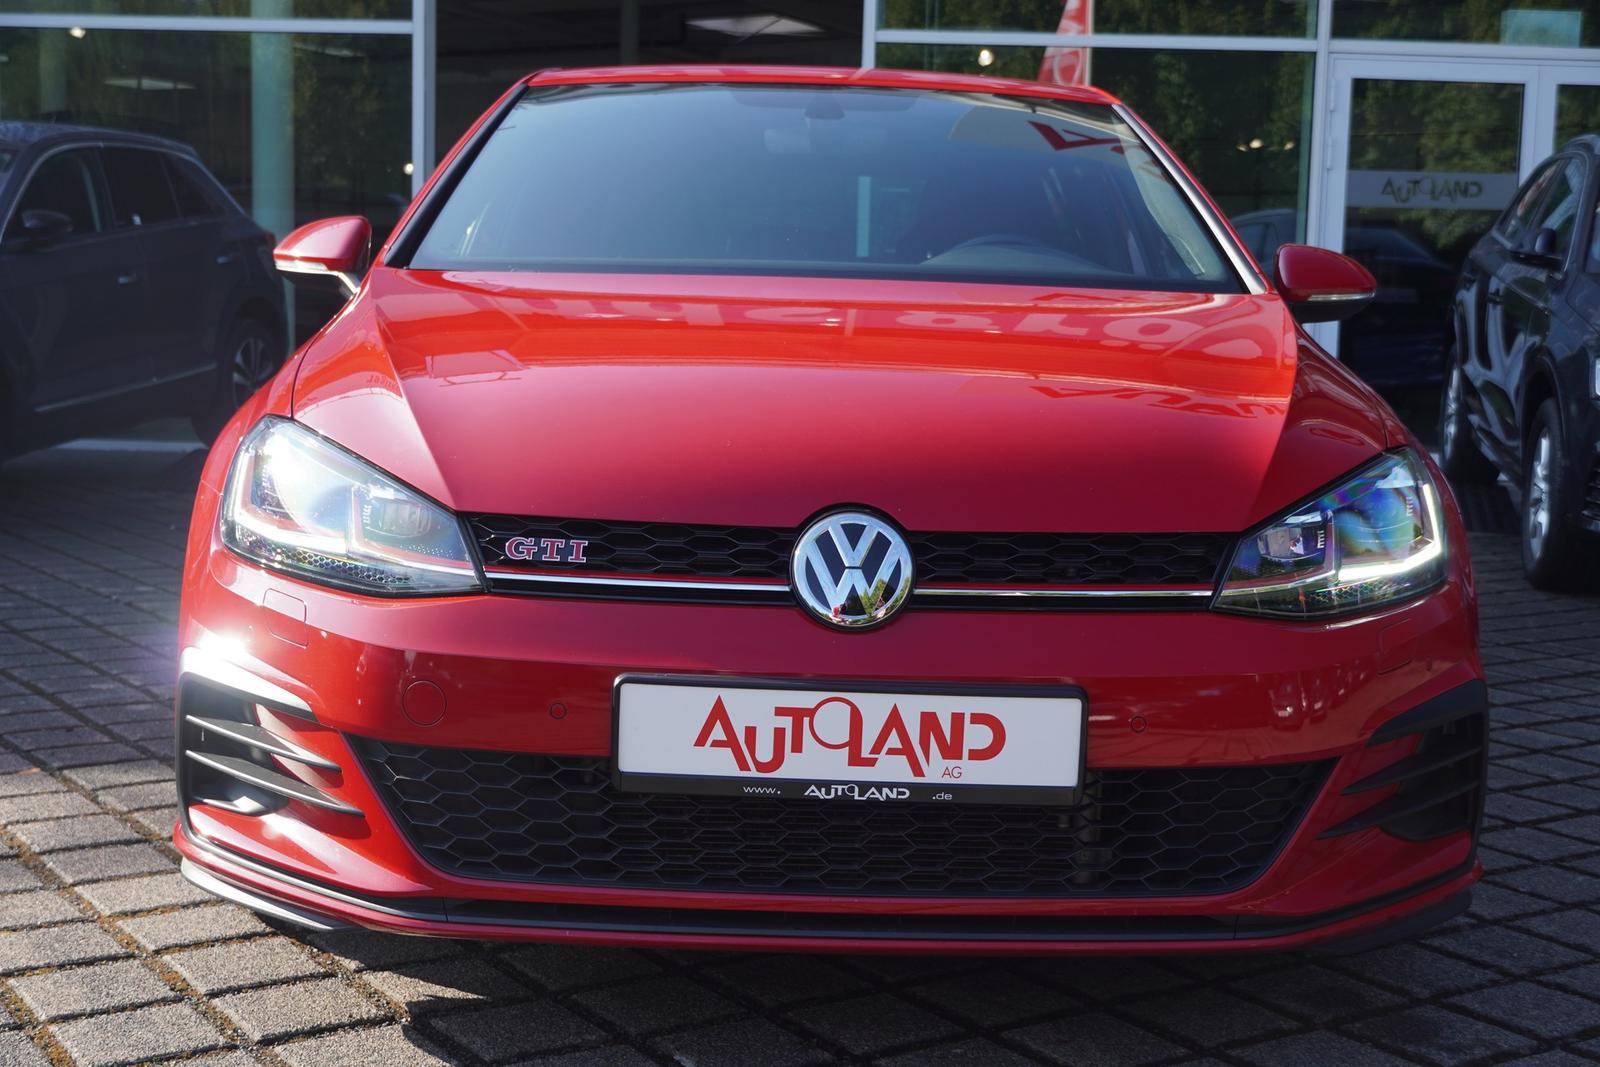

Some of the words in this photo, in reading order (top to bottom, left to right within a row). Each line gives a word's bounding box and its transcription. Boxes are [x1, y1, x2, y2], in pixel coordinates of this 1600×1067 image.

[505, 536, 589, 563] GTI
[693, 694, 1007, 778] AUTOLAND
[941, 766, 963, 779] AG
[743, 786, 782, 795] www.
[803, 784, 911, 801] AUTOLAND
[932, 792, 953, 801] .de
